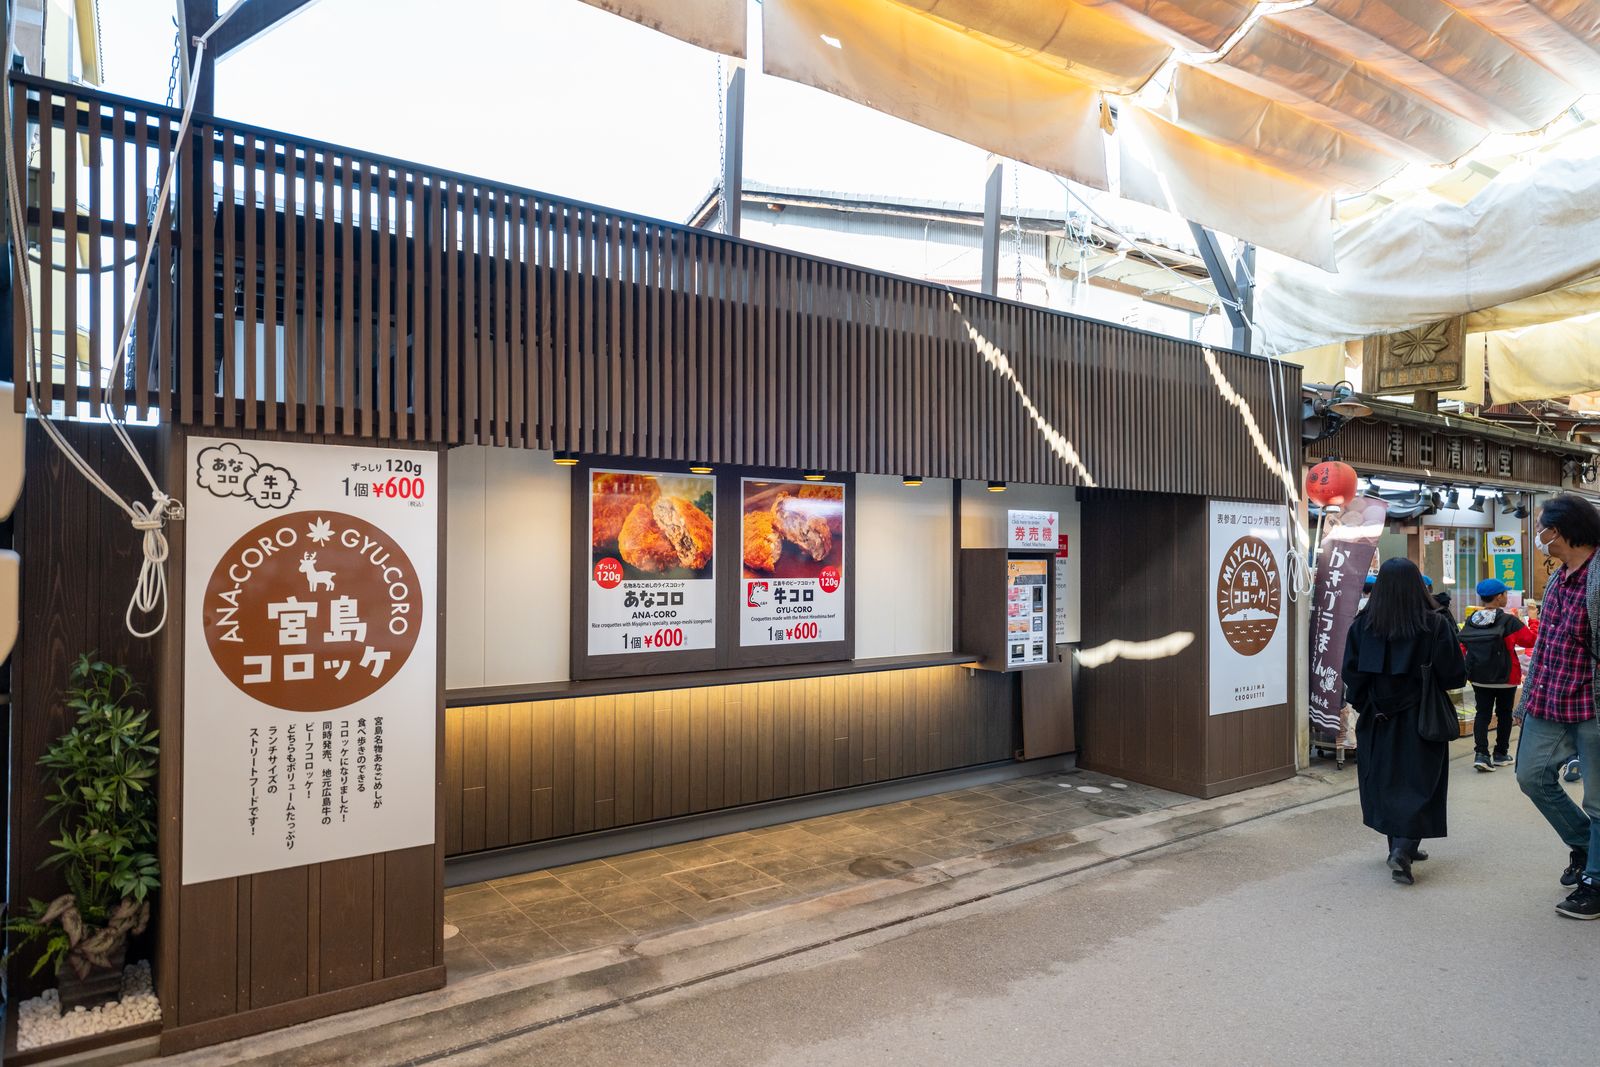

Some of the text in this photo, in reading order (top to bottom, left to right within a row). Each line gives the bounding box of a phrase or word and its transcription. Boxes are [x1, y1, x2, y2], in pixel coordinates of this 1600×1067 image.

[1387, 424, 1512, 477] 津田清風堂
[212, 457, 244, 473] あな
[351, 459, 422, 476] ずっしり 120g
[217, 474, 239, 484] コロ
[263, 475, 279, 489] 牛
[372, 477, 425, 499] ¥600
[260, 491, 281, 501] コロ
[1015, 526, 1052, 542] 券売機
[1222, 543, 1276, 586] MIYAJIMA
[215, 526, 298, 644] ANA-CORO
[340, 528, 411, 636] GYU-CORO
[596, 571, 621, 582] 120g
[820, 578, 838, 588] 120g
[1241, 570, 1259, 587] 宮島
[624, 590, 684, 608] あなコロ
[773, 587, 814, 605] 牛コロ
[1233, 590, 1266, 604] コロッケ
[631, 610, 677, 619] ANA-CORO
[776, 605, 813, 614] GYU-CORO
[267, 594, 368, 646] 宮島
[644, 628, 683, 649] ¥600
[785, 622, 818, 641] ¥600
[243, 646, 391, 684] コロッケ
[1234, 684, 1265, 693] MIYAJIMA
[1234, 691, 1265, 702] CROQUETTE
[267, 726, 278, 794] ランチサイズの
[356, 717, 367, 793] 食べ歩きのできる
[373, 715, 384, 809] 宮島名物あなごめしが
[285, 723, 297, 850] どちらもボリュームたっぷり
